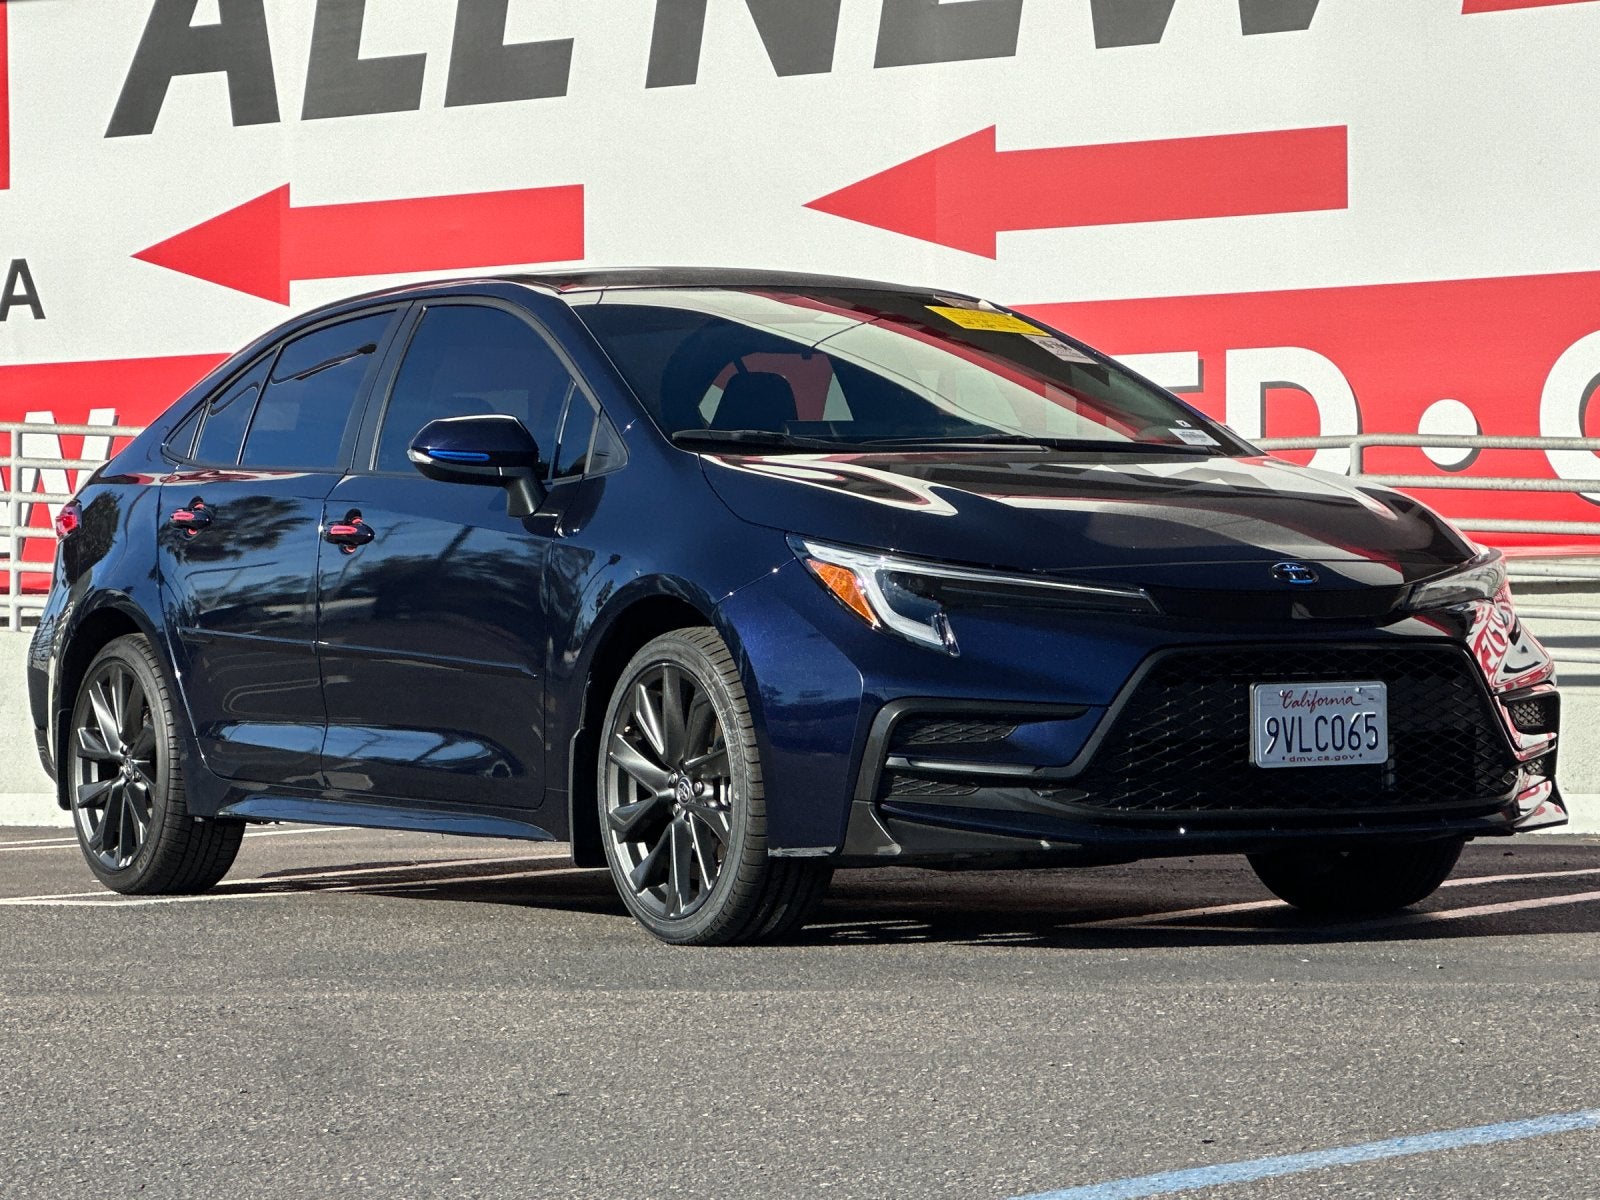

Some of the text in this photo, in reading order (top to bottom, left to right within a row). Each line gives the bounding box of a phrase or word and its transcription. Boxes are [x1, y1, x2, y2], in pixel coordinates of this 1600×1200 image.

[1281, 690, 1362, 713] California
[1265, 712, 1379, 755] 9VLC065
[1289, 753, 1356, 763] dmv.ca.gov
